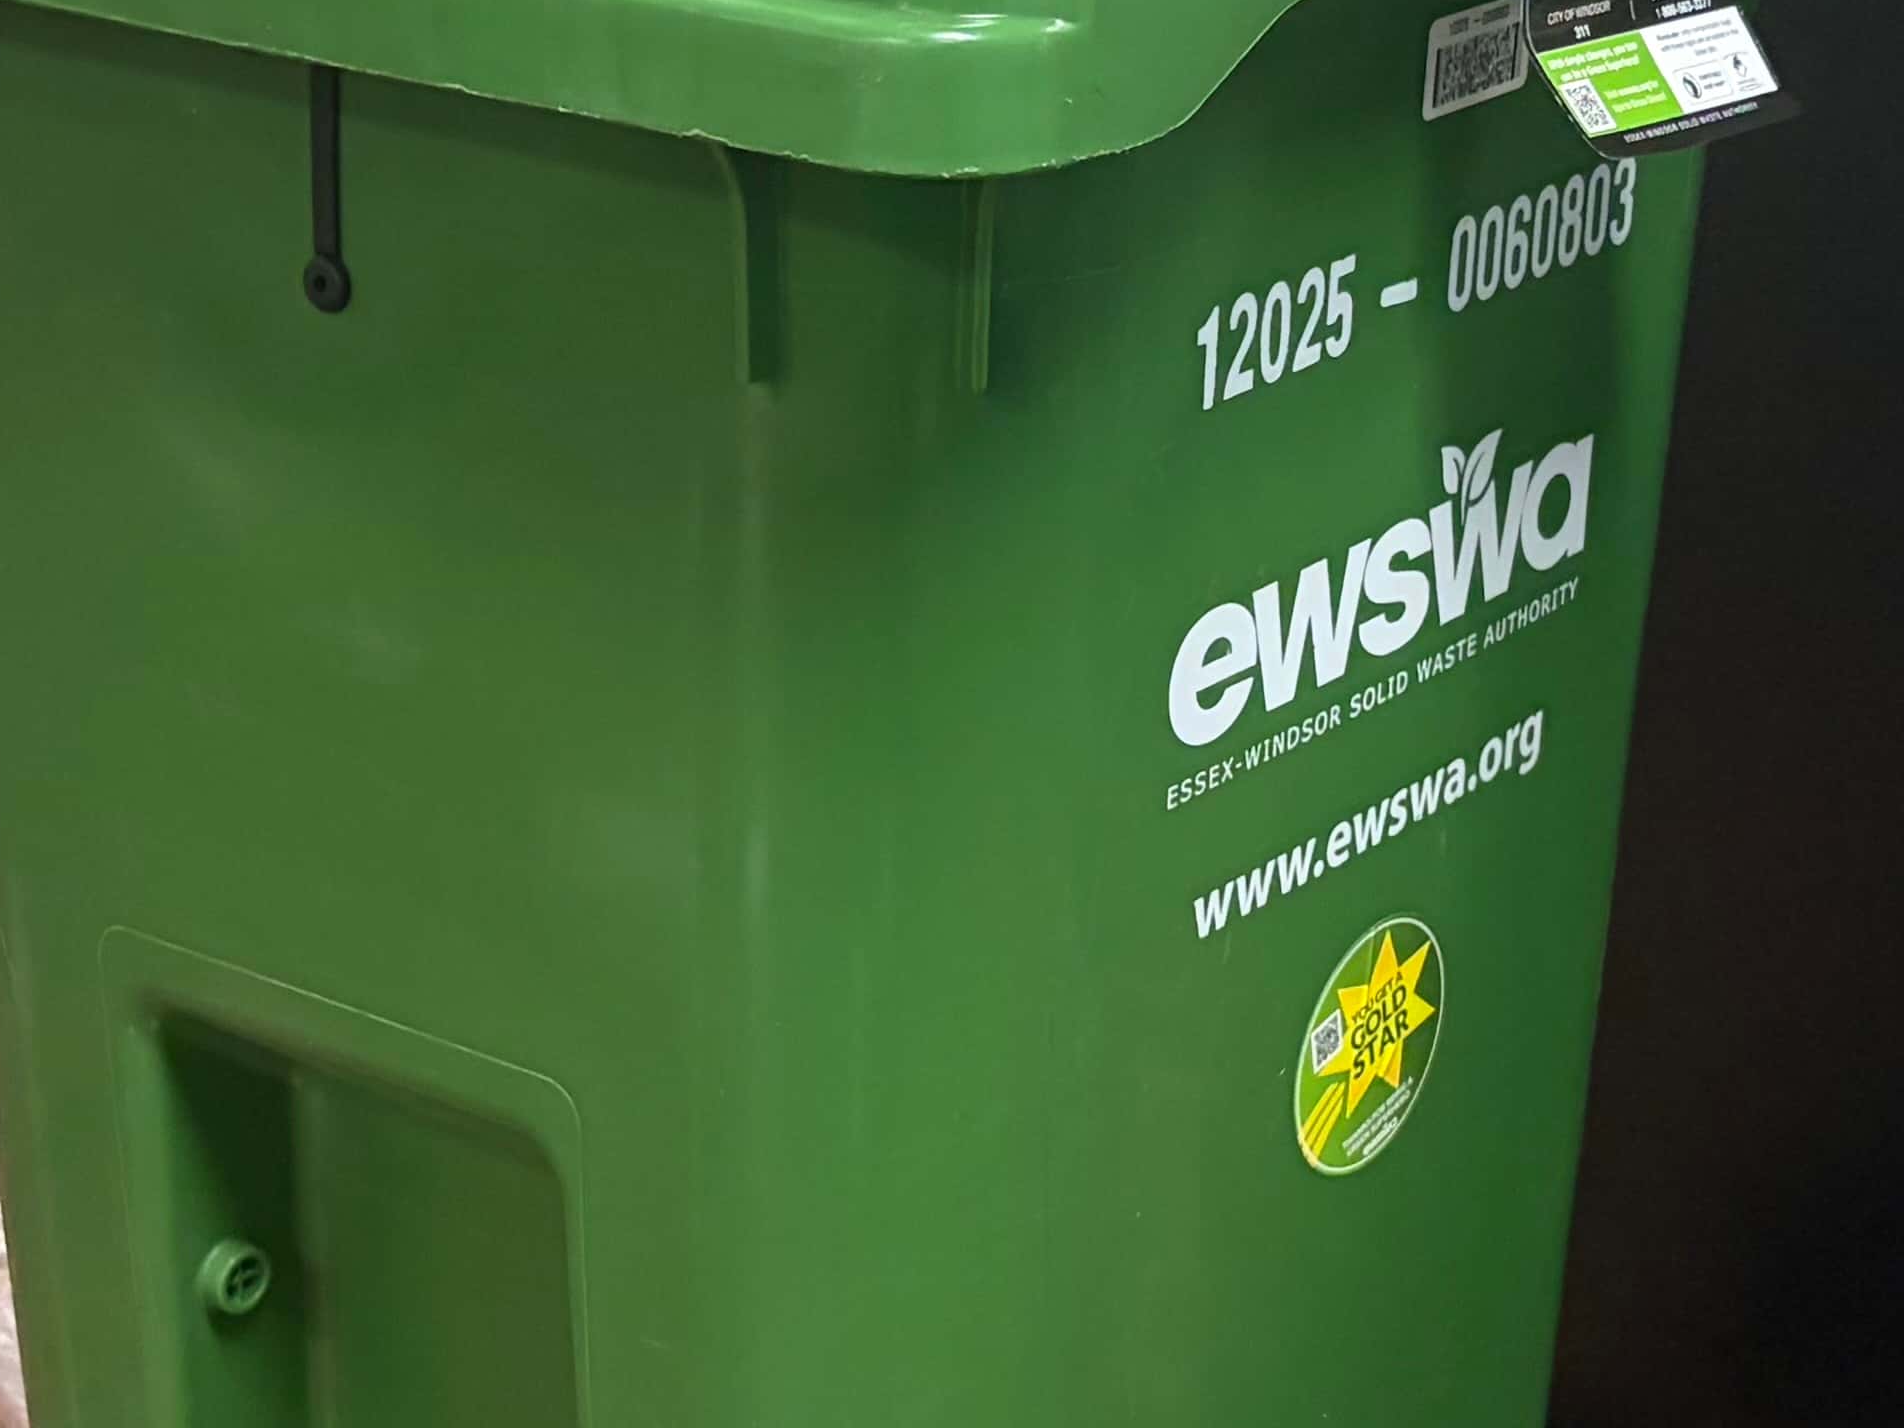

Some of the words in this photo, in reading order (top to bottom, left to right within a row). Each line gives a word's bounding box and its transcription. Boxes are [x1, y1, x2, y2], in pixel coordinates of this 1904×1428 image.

[1197, 253, 1357, 411] 12025
[1447, 156, 1636, 313] 0060803
[1165, 704, 1343, 811] ESSEX-WINDSOR
[1349, 670, 1409, 720] SOLID
[1415, 633, 1479, 684] WASTE
[1482, 576, 1580, 652] AUTHORITY
[1169, 433, 1594, 747] ewswa
[1192, 709, 1546, 940] www.ewswa.org
[1351, 984, 1408, 1050] GOLD
[1352, 1008, 1409, 1080] STAR
